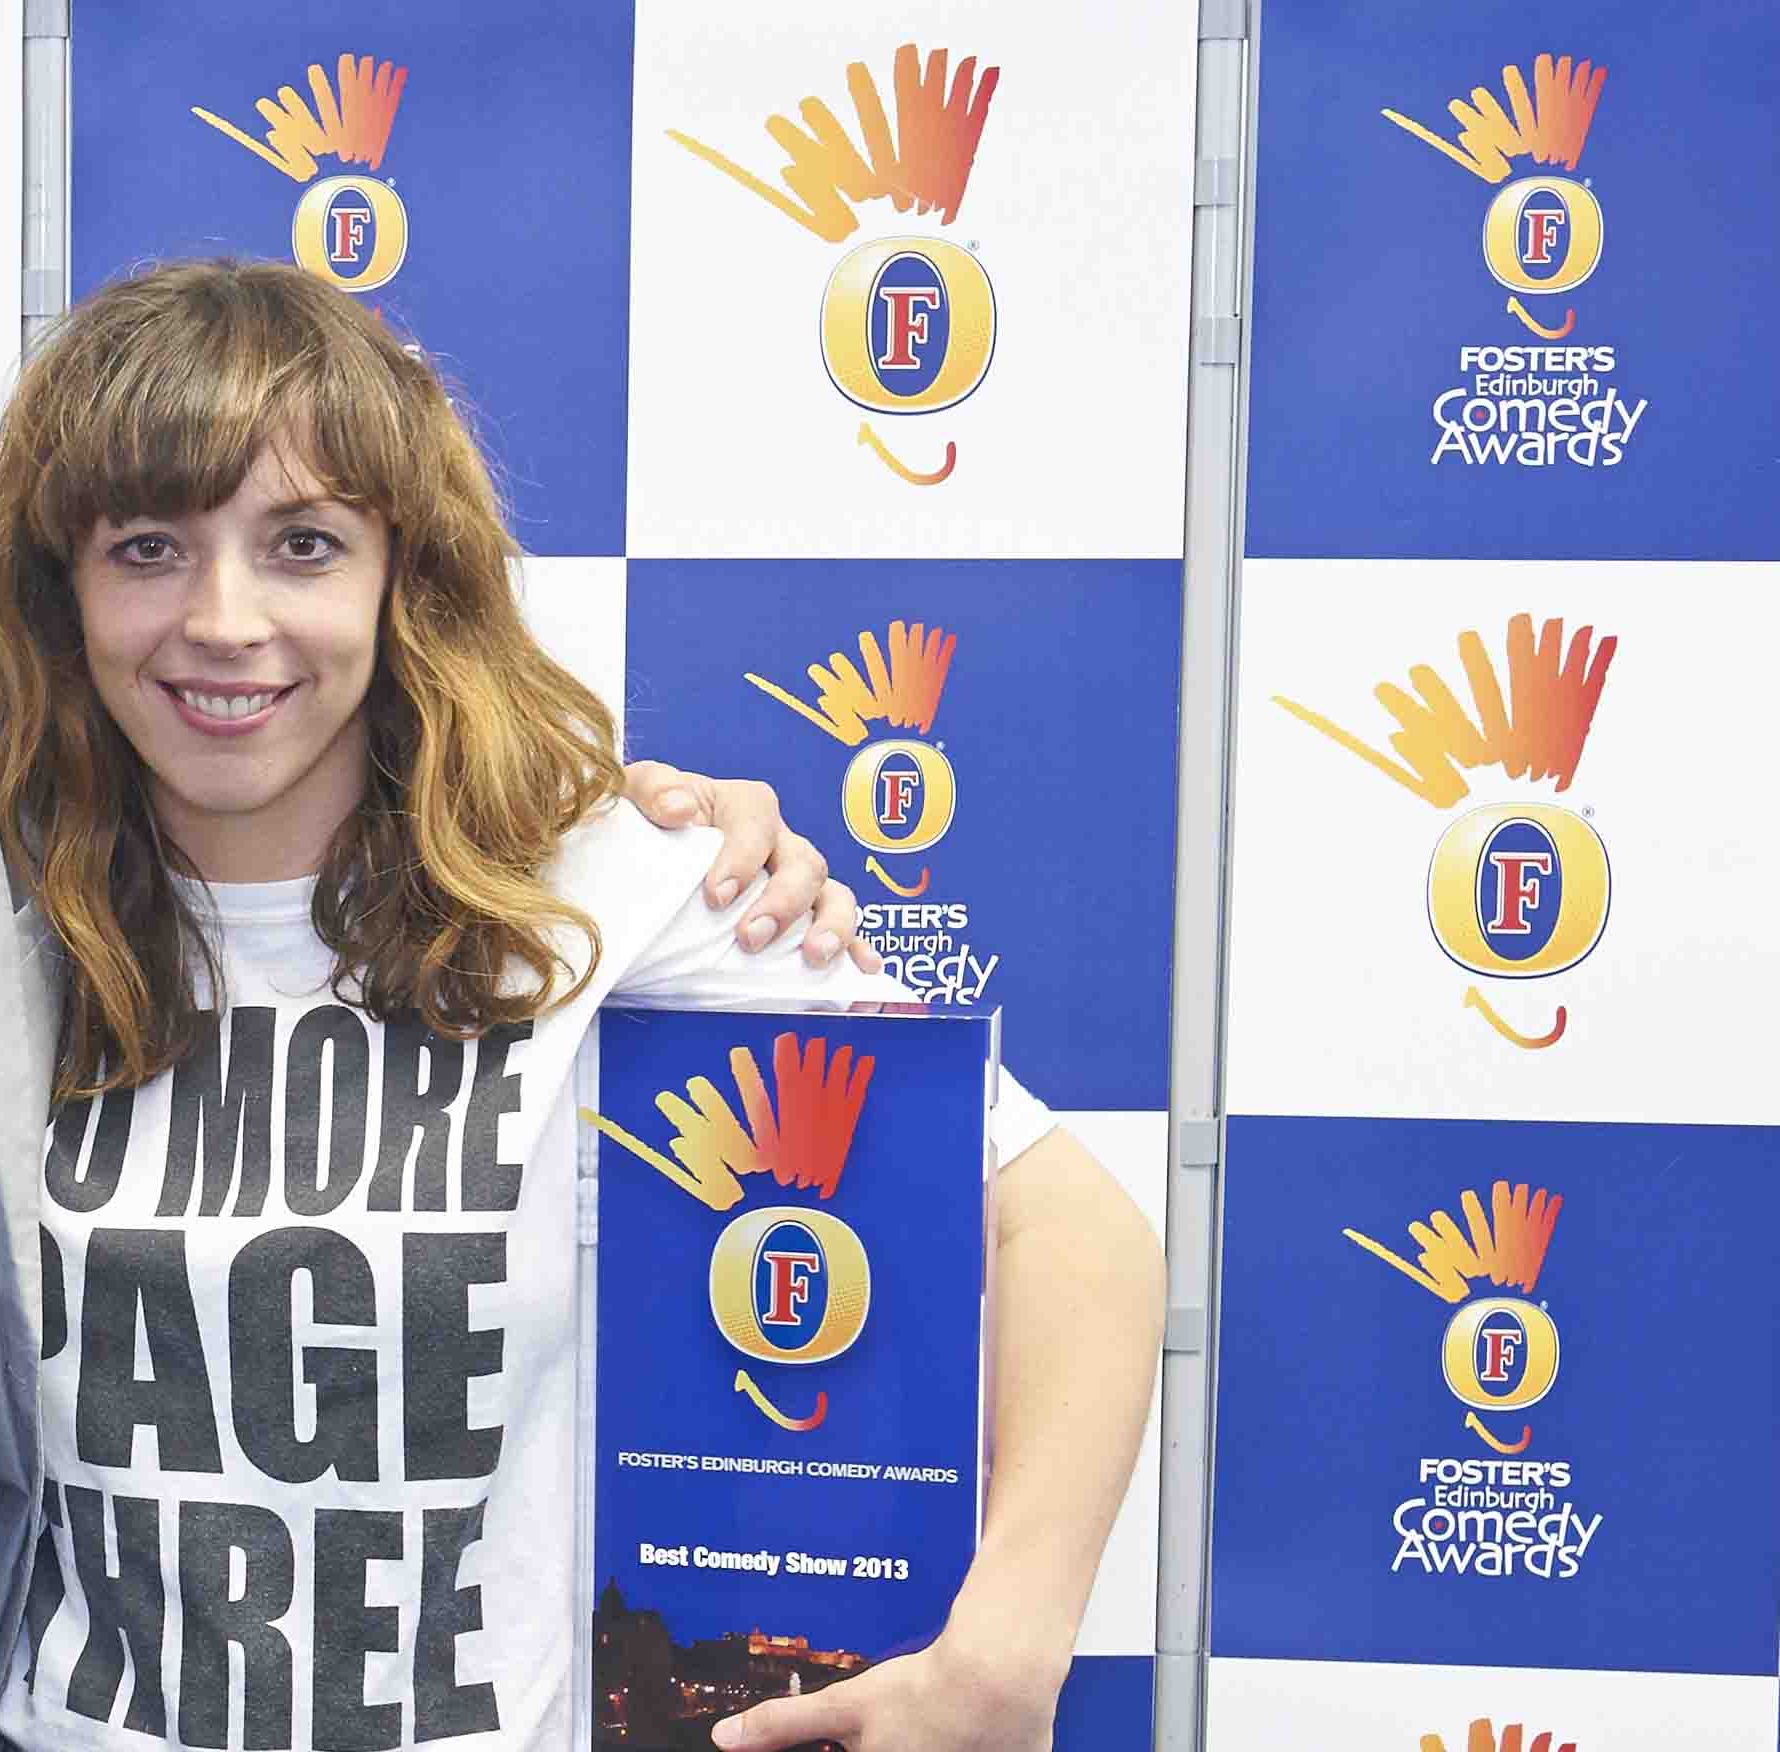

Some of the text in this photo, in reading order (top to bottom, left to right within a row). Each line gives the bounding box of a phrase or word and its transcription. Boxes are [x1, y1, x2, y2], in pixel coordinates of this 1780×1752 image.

[1461, 346, 1614, 372] FOSTER'S
[1476, 374, 1598, 399] Edinburgh
[1431, 388, 1647, 443] Comedy
[1431, 420, 1624, 467] Awards
[157, 1005, 534, 1218] MORE
[39, 1222, 507, 1483] AGE
[618, 1452, 958, 1484] FOSTER'S EDINBURGH COMEDY AWARDS
[1420, 1459, 1571, 1486] FOSTER'S
[1434, 1486, 1555, 1511] Edinburgh
[1392, 1498, 1604, 1557] Comedy
[640, 1543, 910, 1581] Best Comedy Show 2013
[1391, 1532, 1580, 1579] Awards
